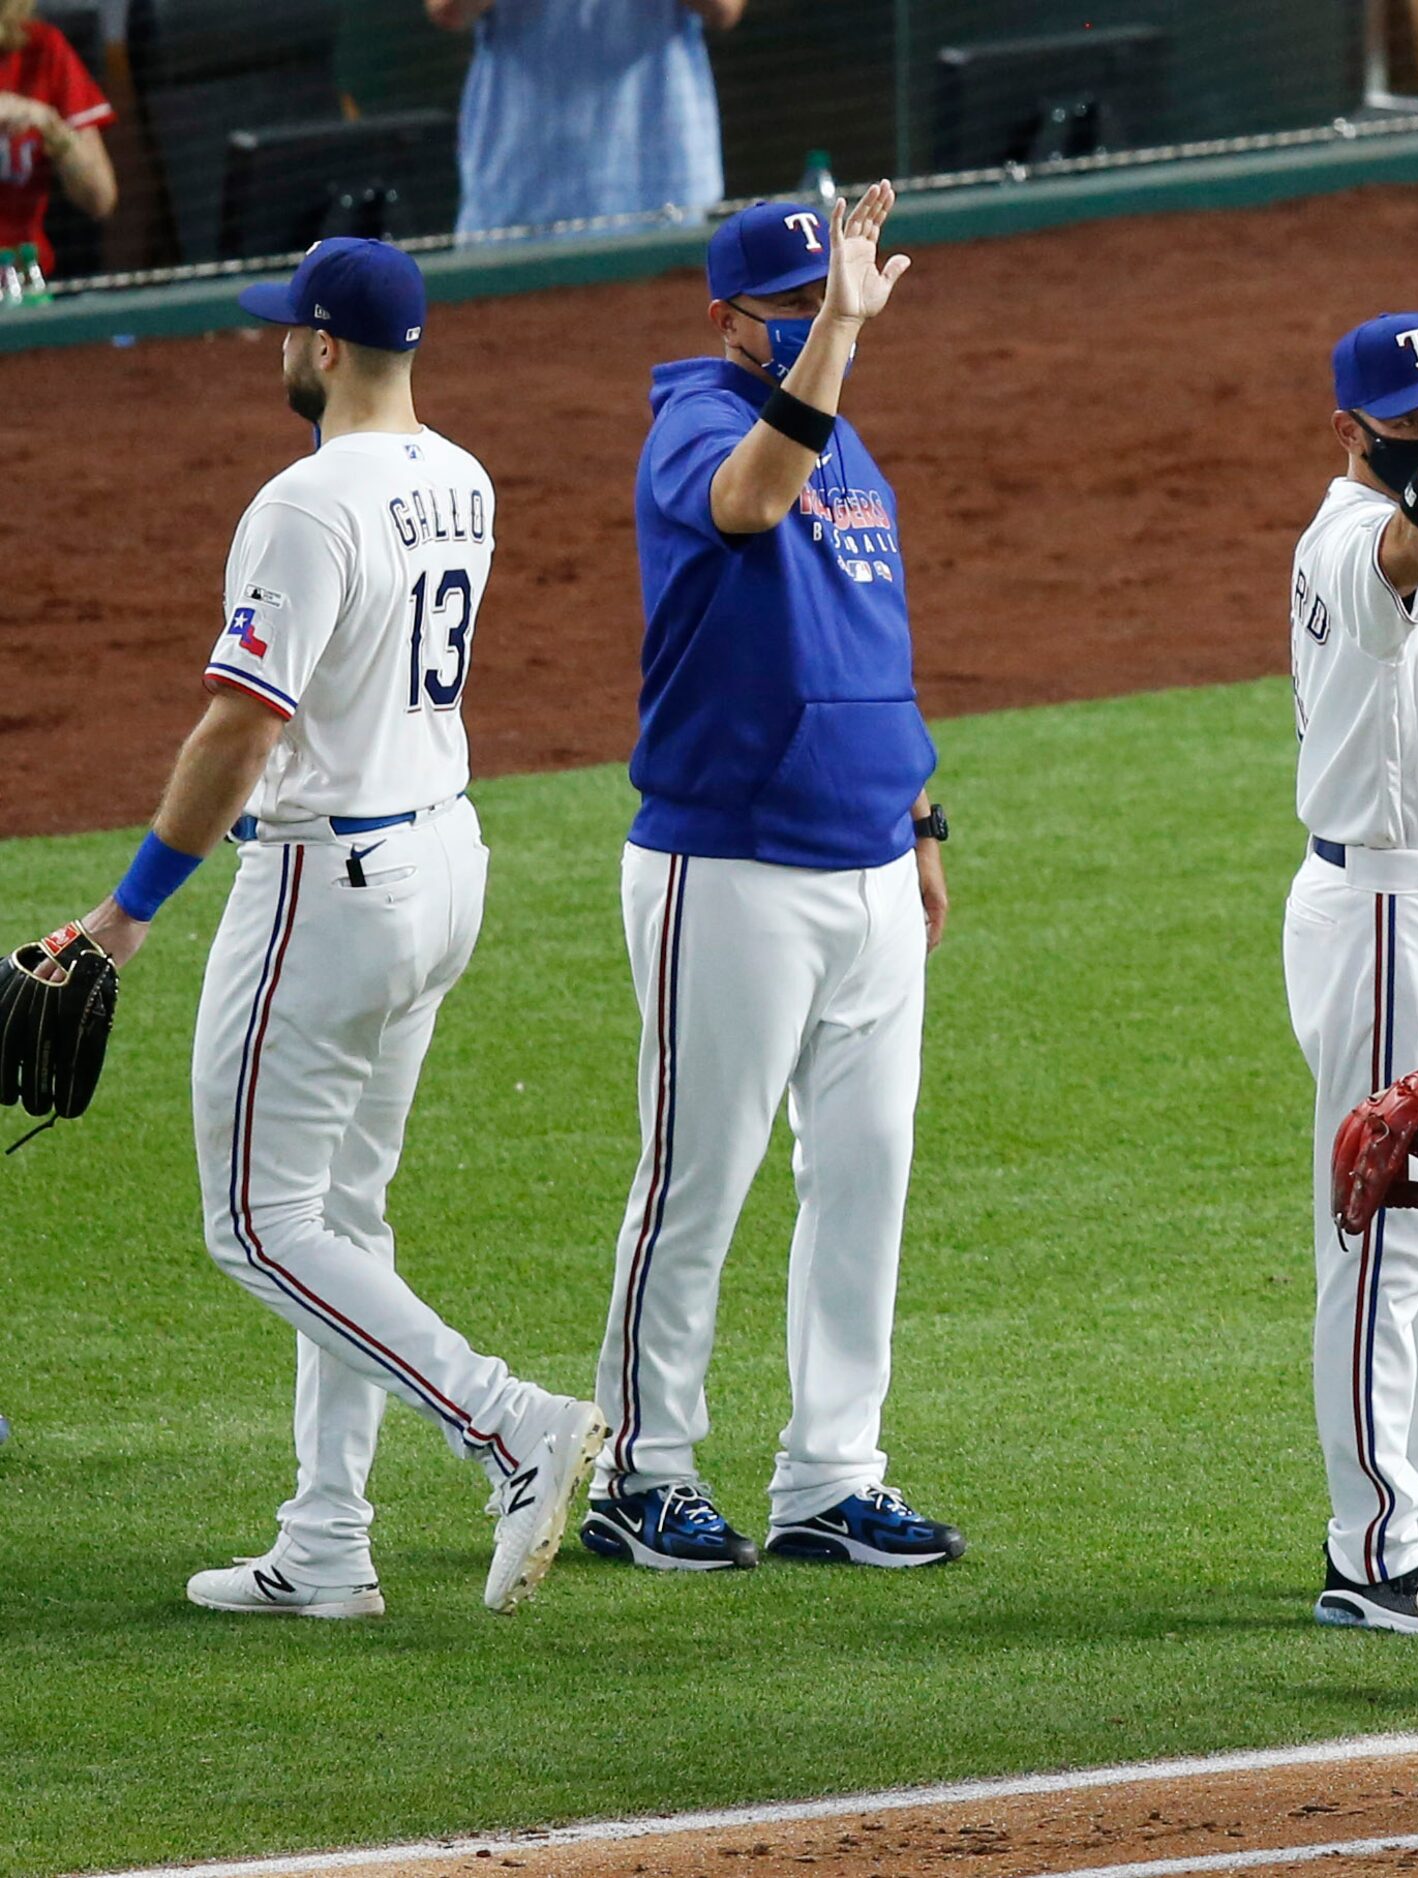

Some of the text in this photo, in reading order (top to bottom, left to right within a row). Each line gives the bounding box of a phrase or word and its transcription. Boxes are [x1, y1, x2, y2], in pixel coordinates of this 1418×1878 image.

[784, 212, 823, 253] T
[389, 488, 485, 549] GALLO
[405, 568, 474, 713] 13
